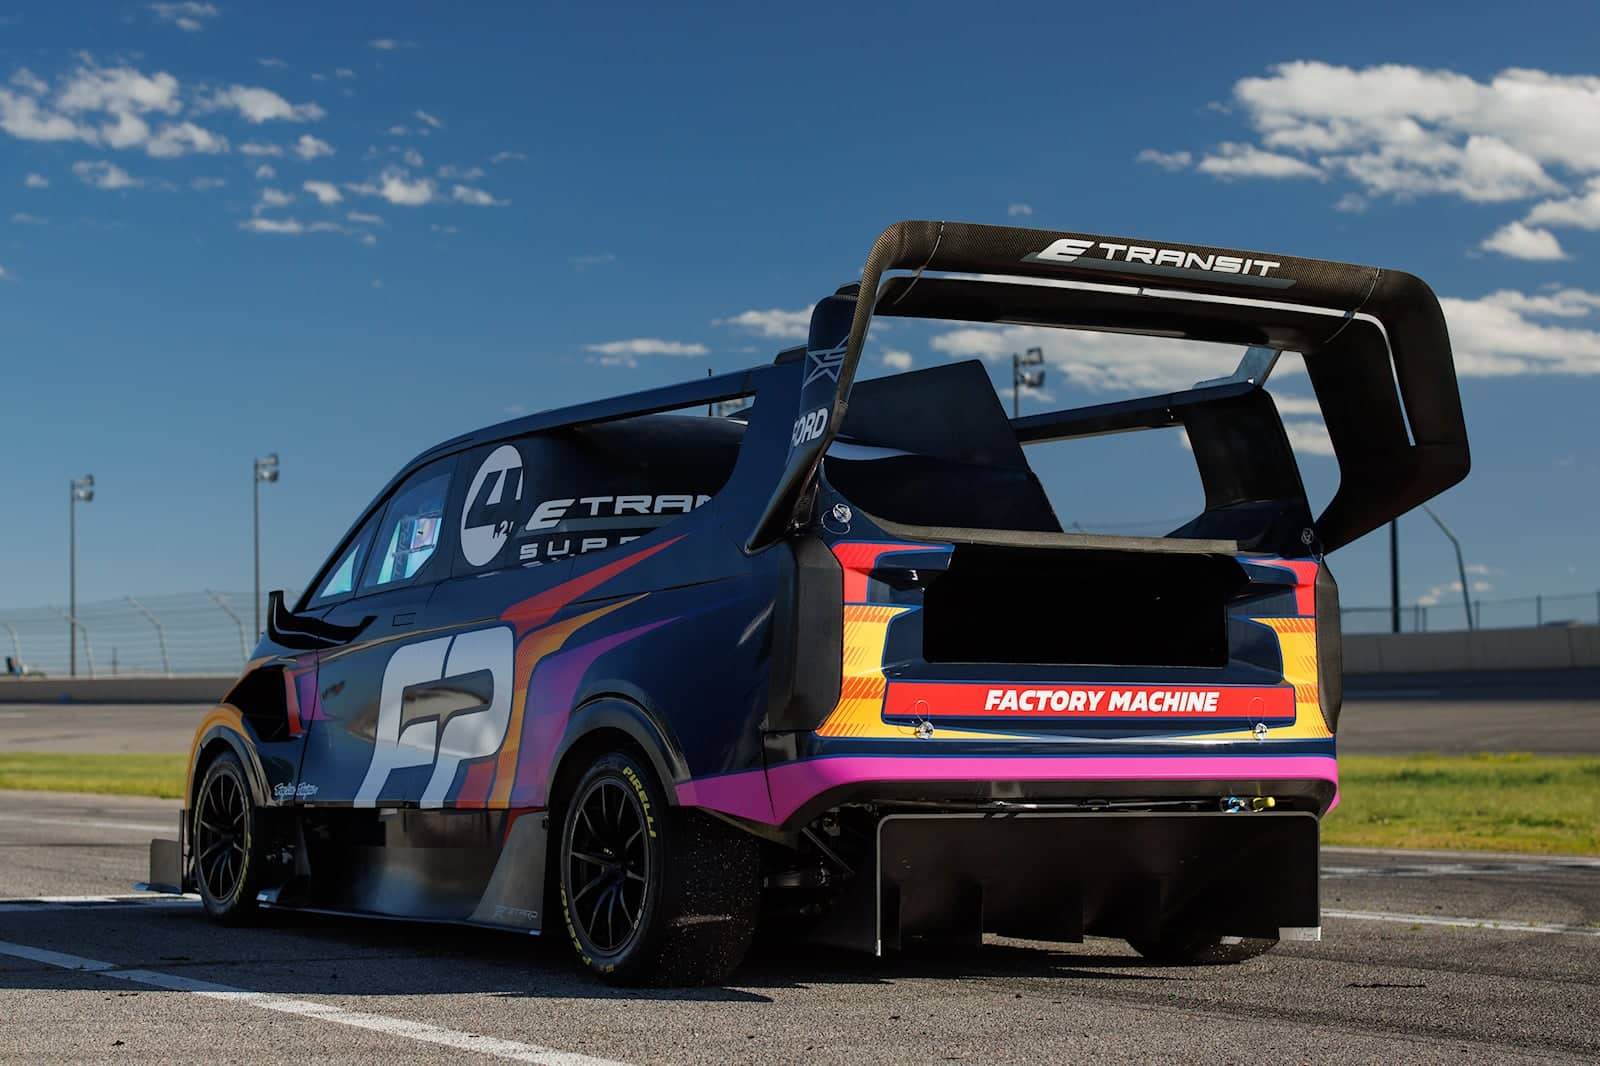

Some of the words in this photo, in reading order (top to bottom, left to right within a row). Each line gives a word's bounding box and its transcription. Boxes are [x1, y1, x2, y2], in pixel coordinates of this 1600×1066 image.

[1098, 242, 1281, 277] TRANSIT
[984, 689, 1106, 712] FACTORY
[1108, 690, 1220, 713] MACHINE
[622, 766, 657, 838] PIRELLI
